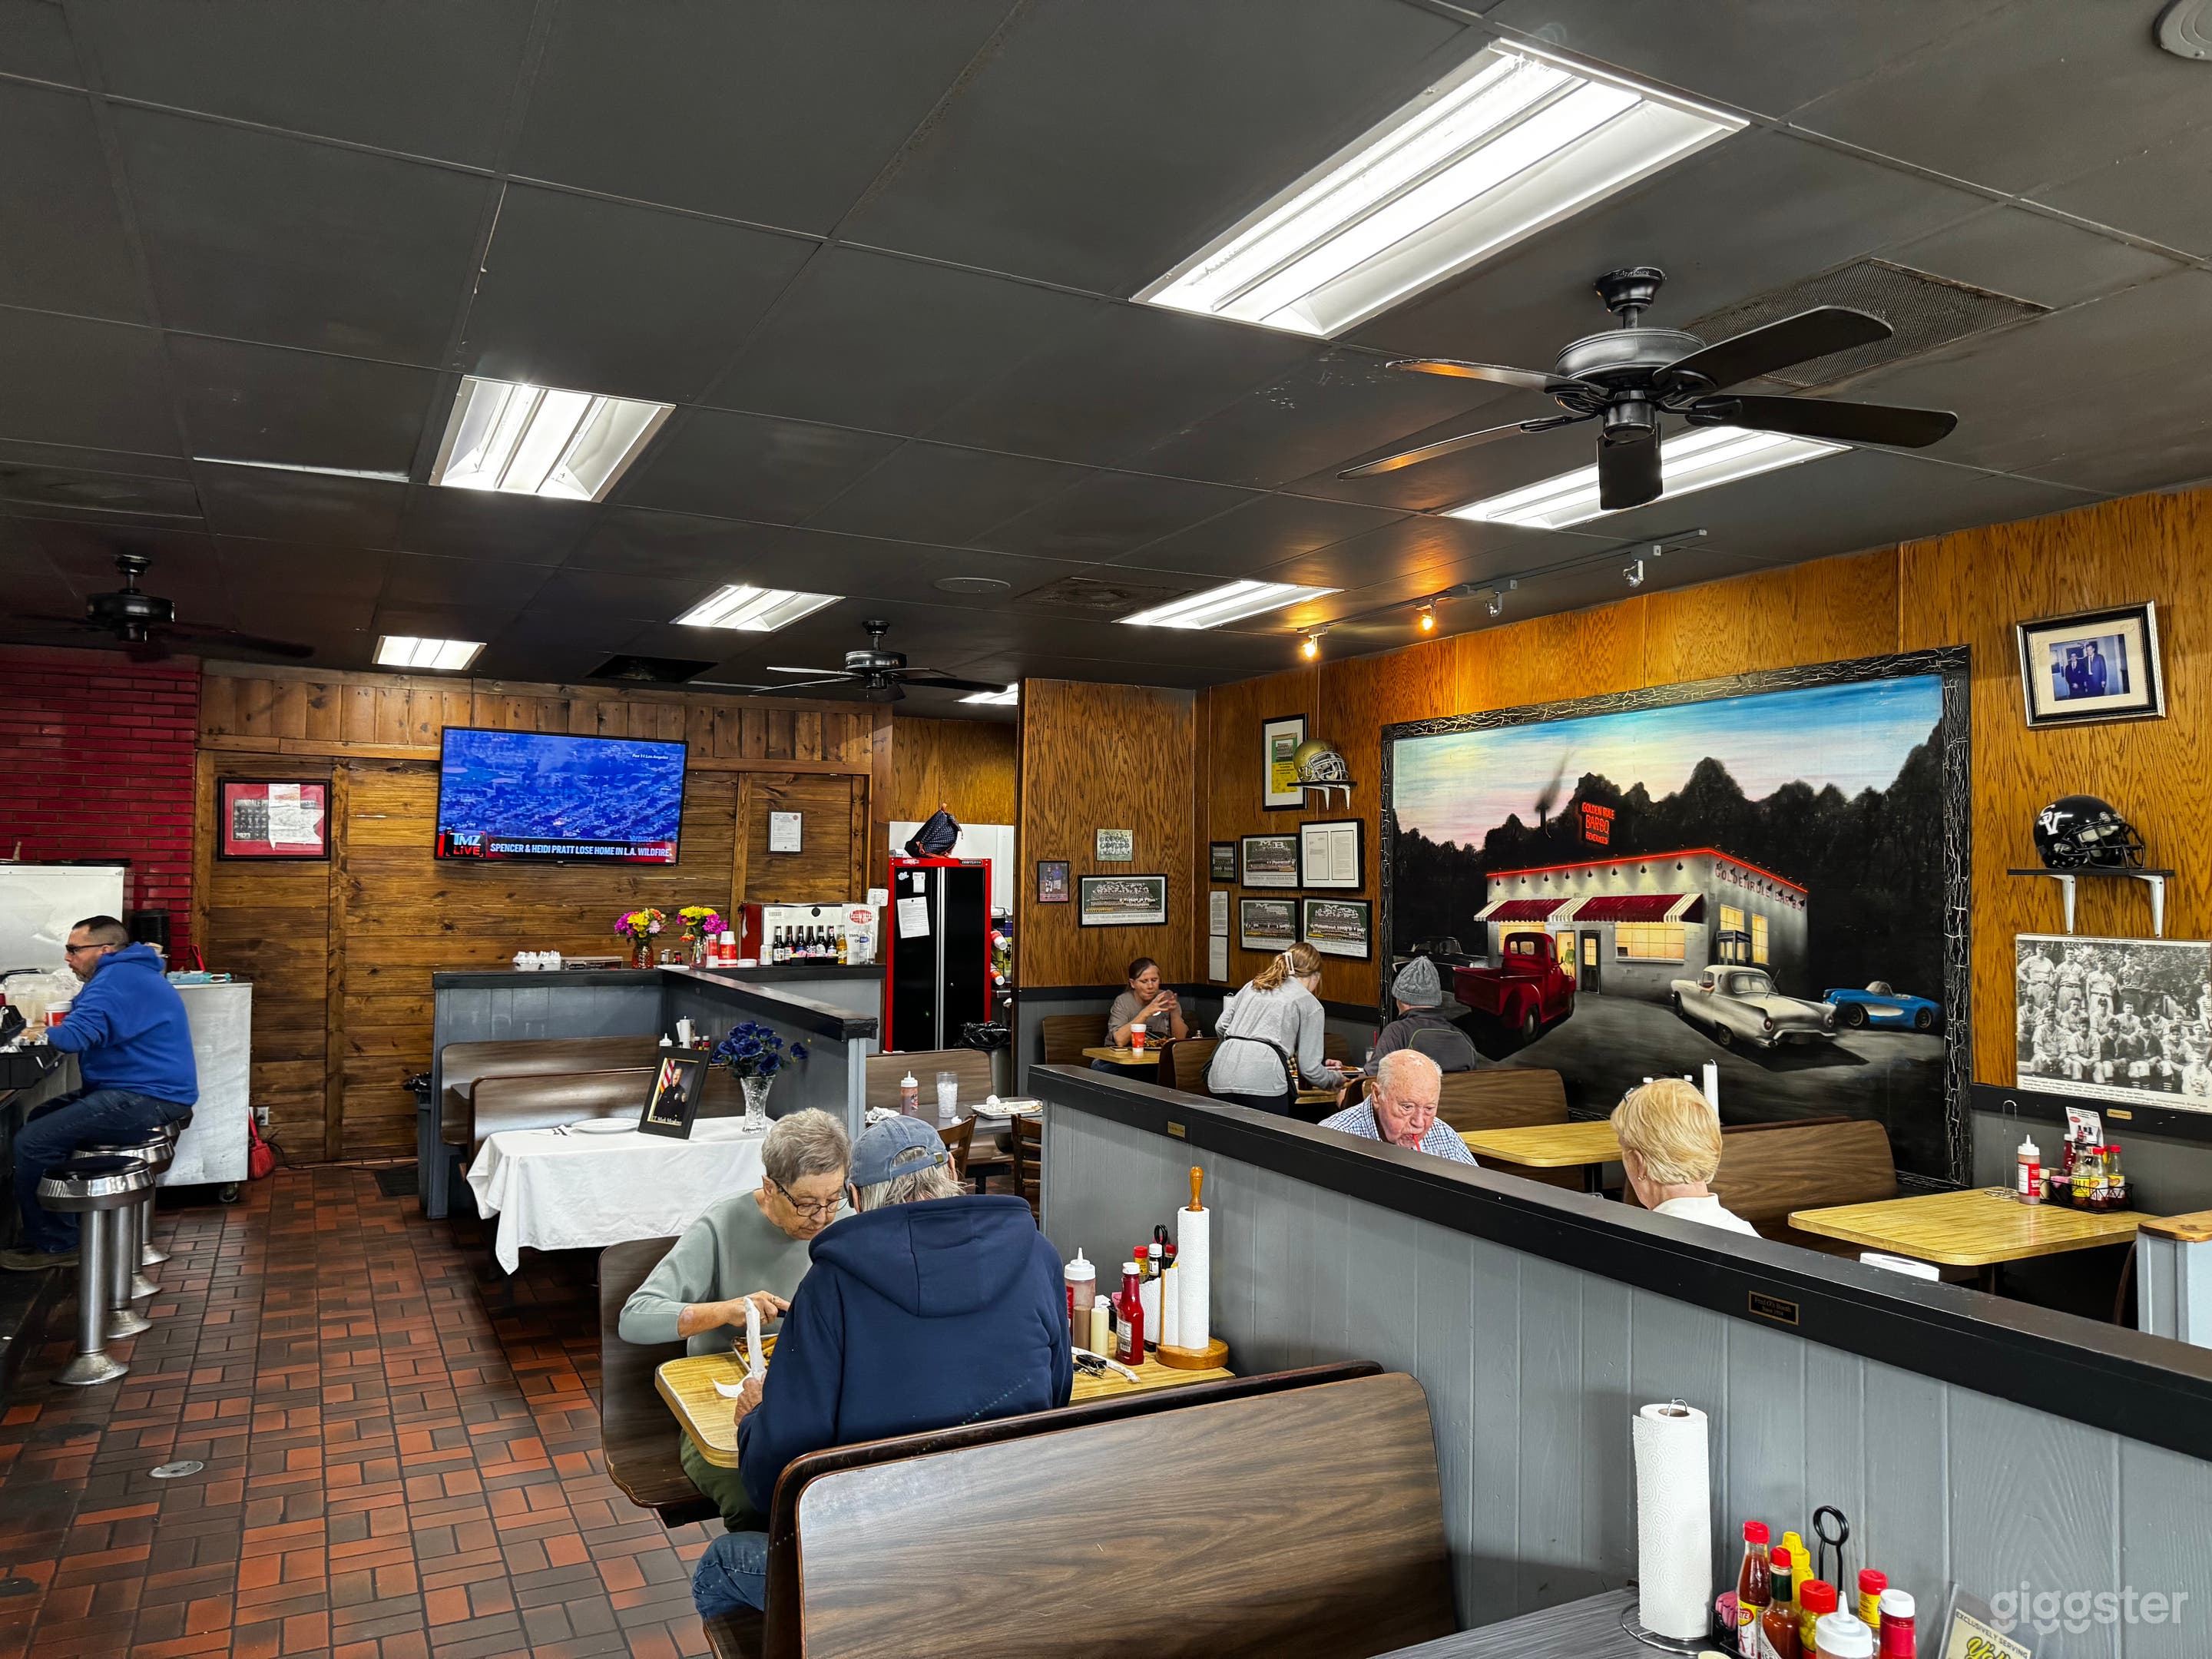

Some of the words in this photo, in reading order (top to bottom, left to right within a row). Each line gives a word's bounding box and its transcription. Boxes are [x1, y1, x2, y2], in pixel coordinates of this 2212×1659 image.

[1582, 802, 1602, 816] GOLDEN
[1602, 806, 1614, 820] RULE
[450, 833, 481, 846] TMZ
[490, 843, 525, 853] SPENCER
[525, 844, 531, 853] &
[531, 844, 551, 853] HEIDI
[551, 845, 575, 854] PRATT
[575, 846, 594, 854] LOSE
[594, 846, 614, 855] HOME
[1740, 1610, 1750, 1619] ETE
[1956, 1611, 1998, 1641] EXCLUSIVELY
[1999, 1637, 2028, 1659] SERVING
